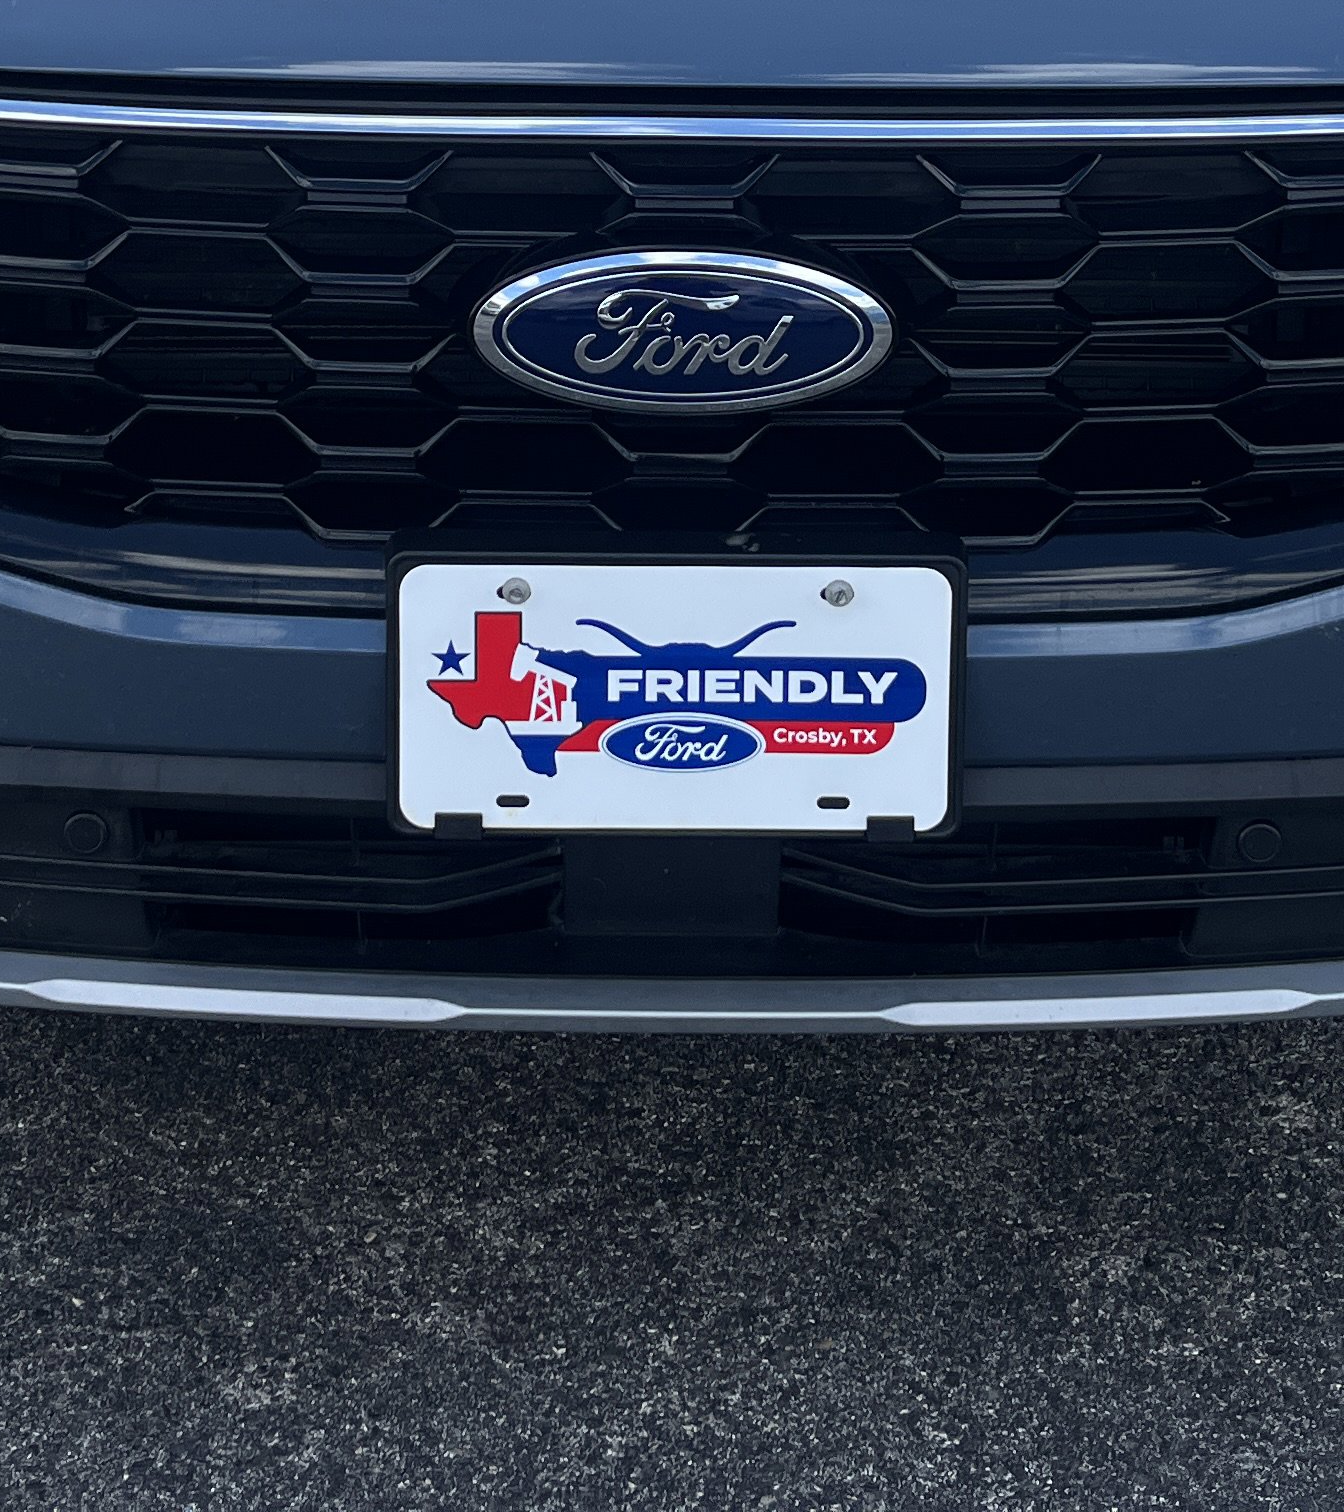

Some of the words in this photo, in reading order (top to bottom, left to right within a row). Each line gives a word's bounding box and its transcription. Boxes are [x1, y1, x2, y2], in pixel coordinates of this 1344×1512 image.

[574, 288, 795, 376] Ford
[607, 668, 899, 705] FRIENDLY
[633, 722, 729, 762] Ford
[772, 727, 847, 747] Crosby,
[849, 727, 878, 745] TX
